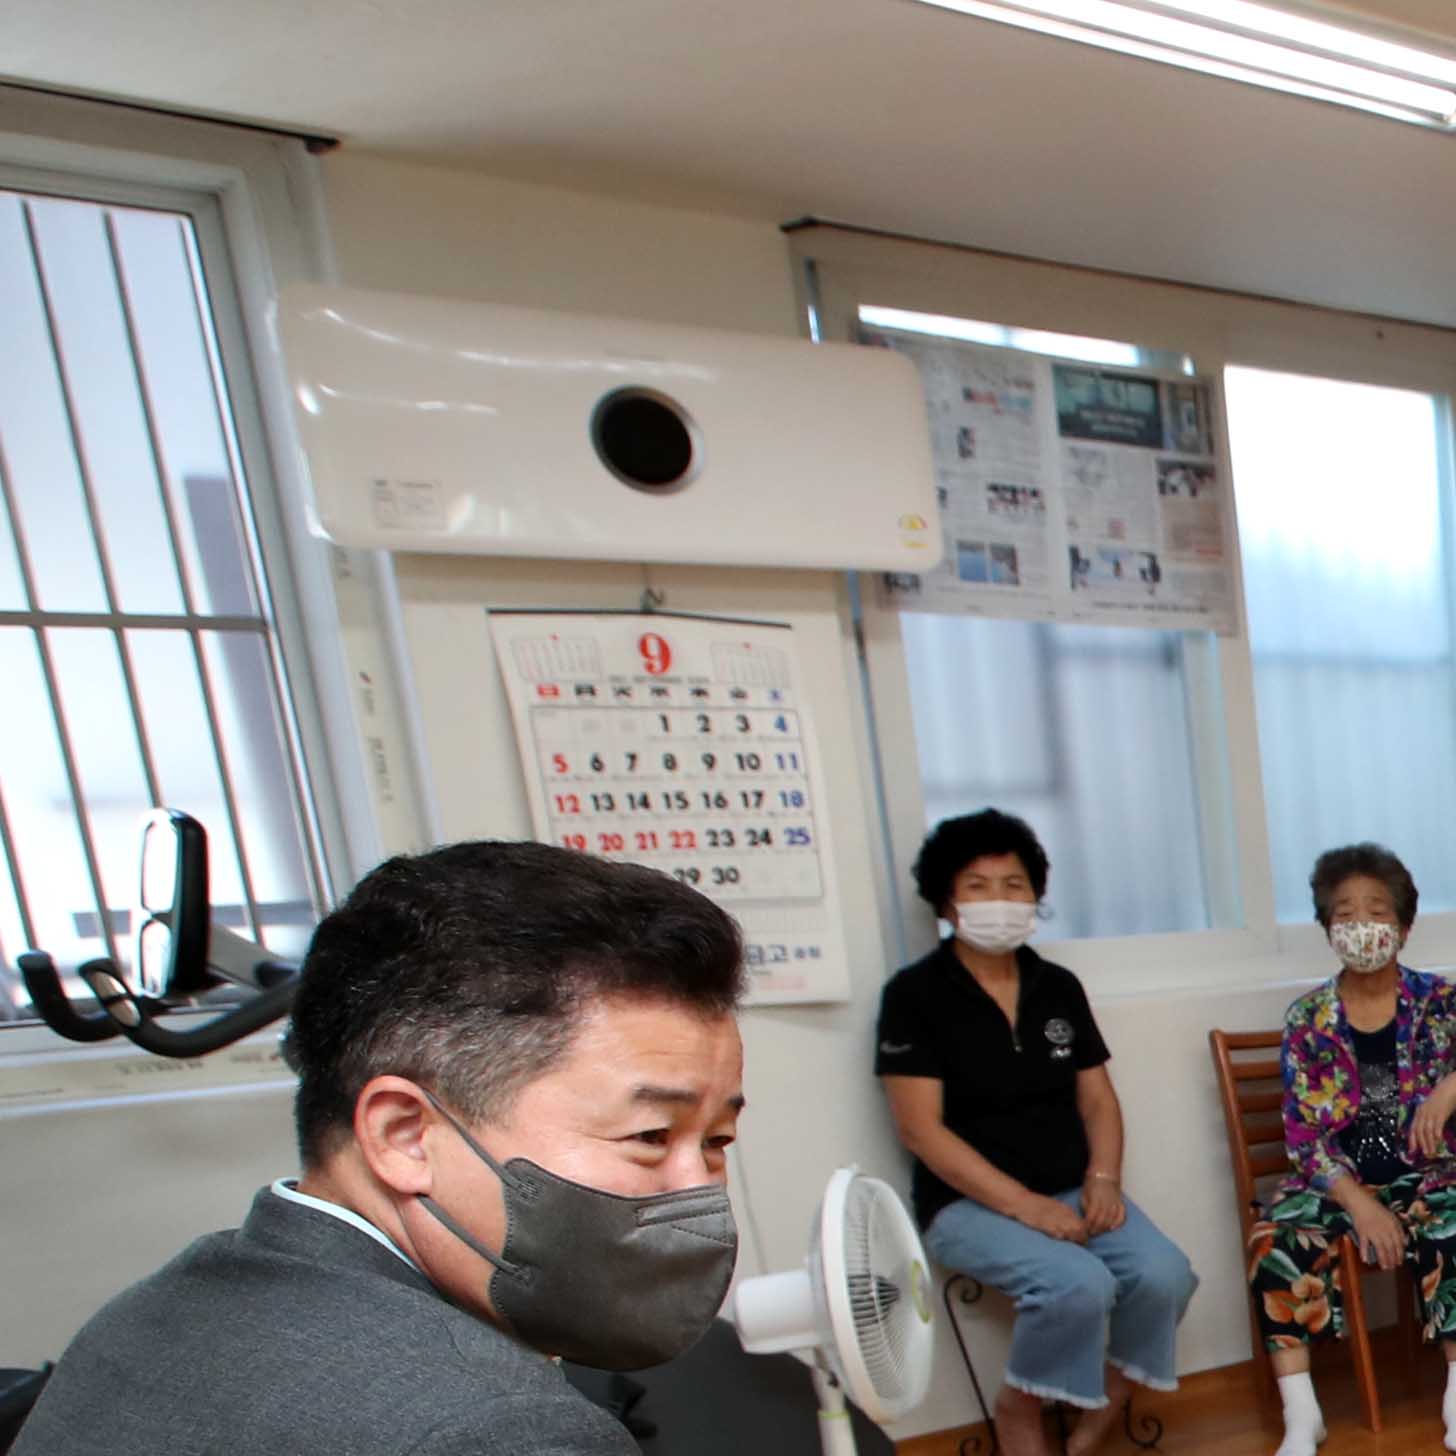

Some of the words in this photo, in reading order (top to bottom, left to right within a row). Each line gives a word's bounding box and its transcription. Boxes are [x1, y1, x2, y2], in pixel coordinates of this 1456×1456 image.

[638, 632, 673, 676] 9
[660, 714, 671, 733] 1
[697, 714, 711, 733] 2
[735, 714, 750, 733] 3
[774, 714, 788, 733] 4
[552, 753, 569, 774] 5
[590, 753, 605, 773] 6
[624, 754, 637, 772] 7
[663, 753, 678, 773] 8
[701, 753, 716, 772] 9
[736, 753, 761, 772] 10
[776, 752, 798, 771] 11
[555, 794, 581, 814] 12
[591, 792, 615, 812] 13
[626, 792, 651, 812] 14
[662, 791, 689, 811] 15
[702, 791, 728, 811] 16
[740, 790, 765, 810] 17
[779, 790, 804, 809] 18
[563, 834, 587, 852] 19
[596, 833, 624, 852] 20
[634, 832, 659, 851] 21
[668, 830, 696, 850] 22
[706, 829, 735, 848] 23
[745, 828, 774, 847] 24
[783, 827, 811, 846] 25
[711, 867, 740, 886] 30
